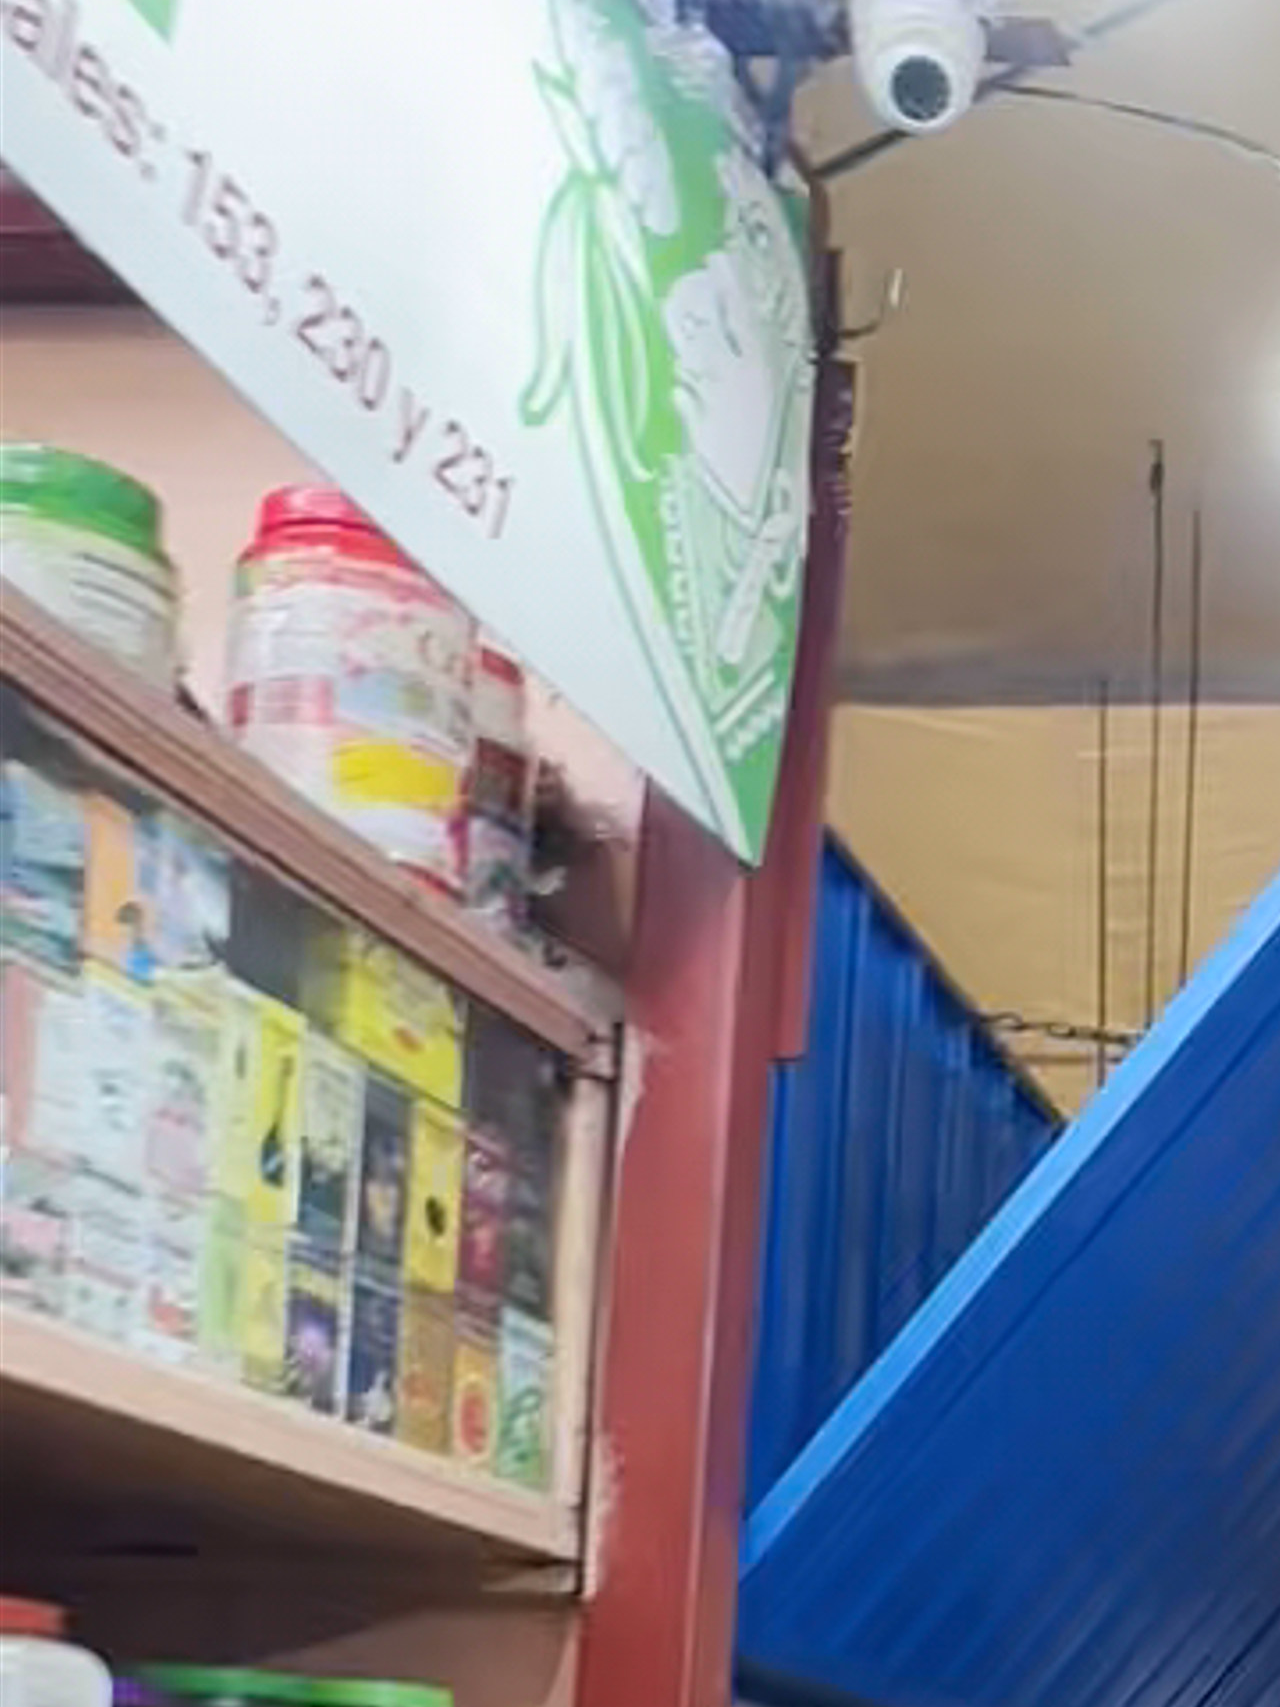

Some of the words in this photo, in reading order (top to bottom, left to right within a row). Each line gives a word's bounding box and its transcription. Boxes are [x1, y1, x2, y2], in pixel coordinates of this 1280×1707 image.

[185, 149, 282, 326] 153,
[296, 276, 391, 411] 230
[392, 388, 430, 464] y
[433, 420, 518, 540] 231
